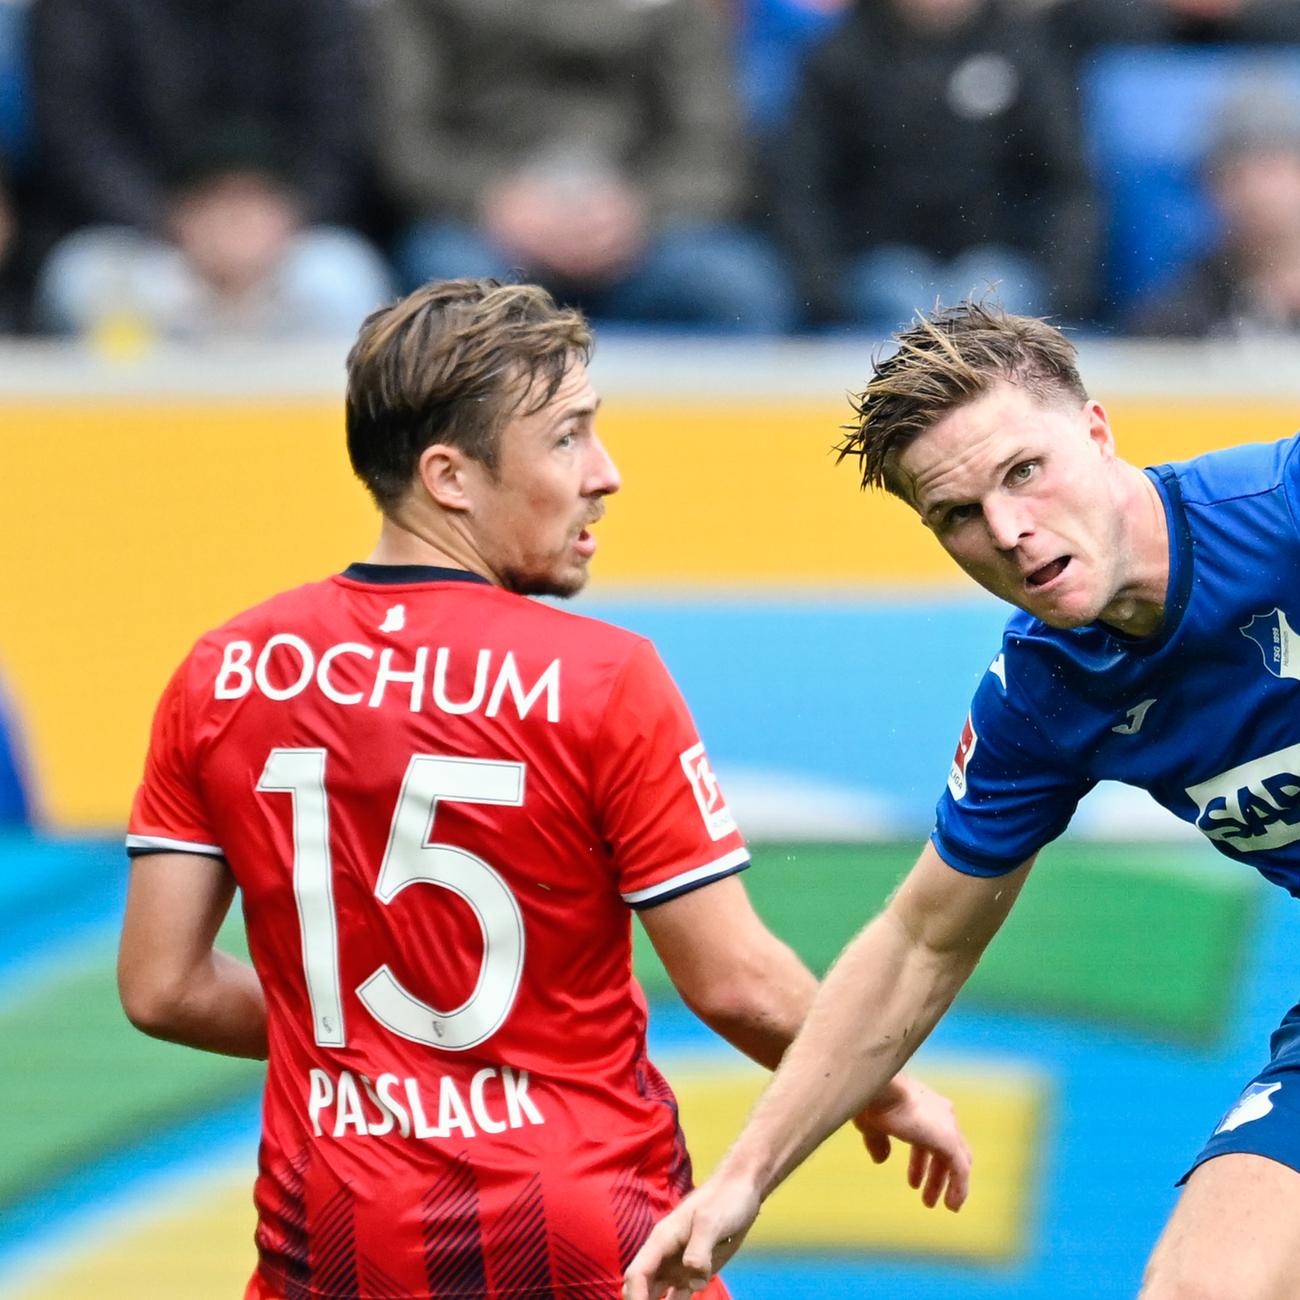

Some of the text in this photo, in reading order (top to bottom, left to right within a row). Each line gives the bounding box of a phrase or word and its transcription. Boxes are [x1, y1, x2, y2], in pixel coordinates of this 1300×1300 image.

[214, 633, 561, 723] BOCHUM
[255, 748, 527, 1051] 15
[308, 1066, 545, 1139] PASSLACK
